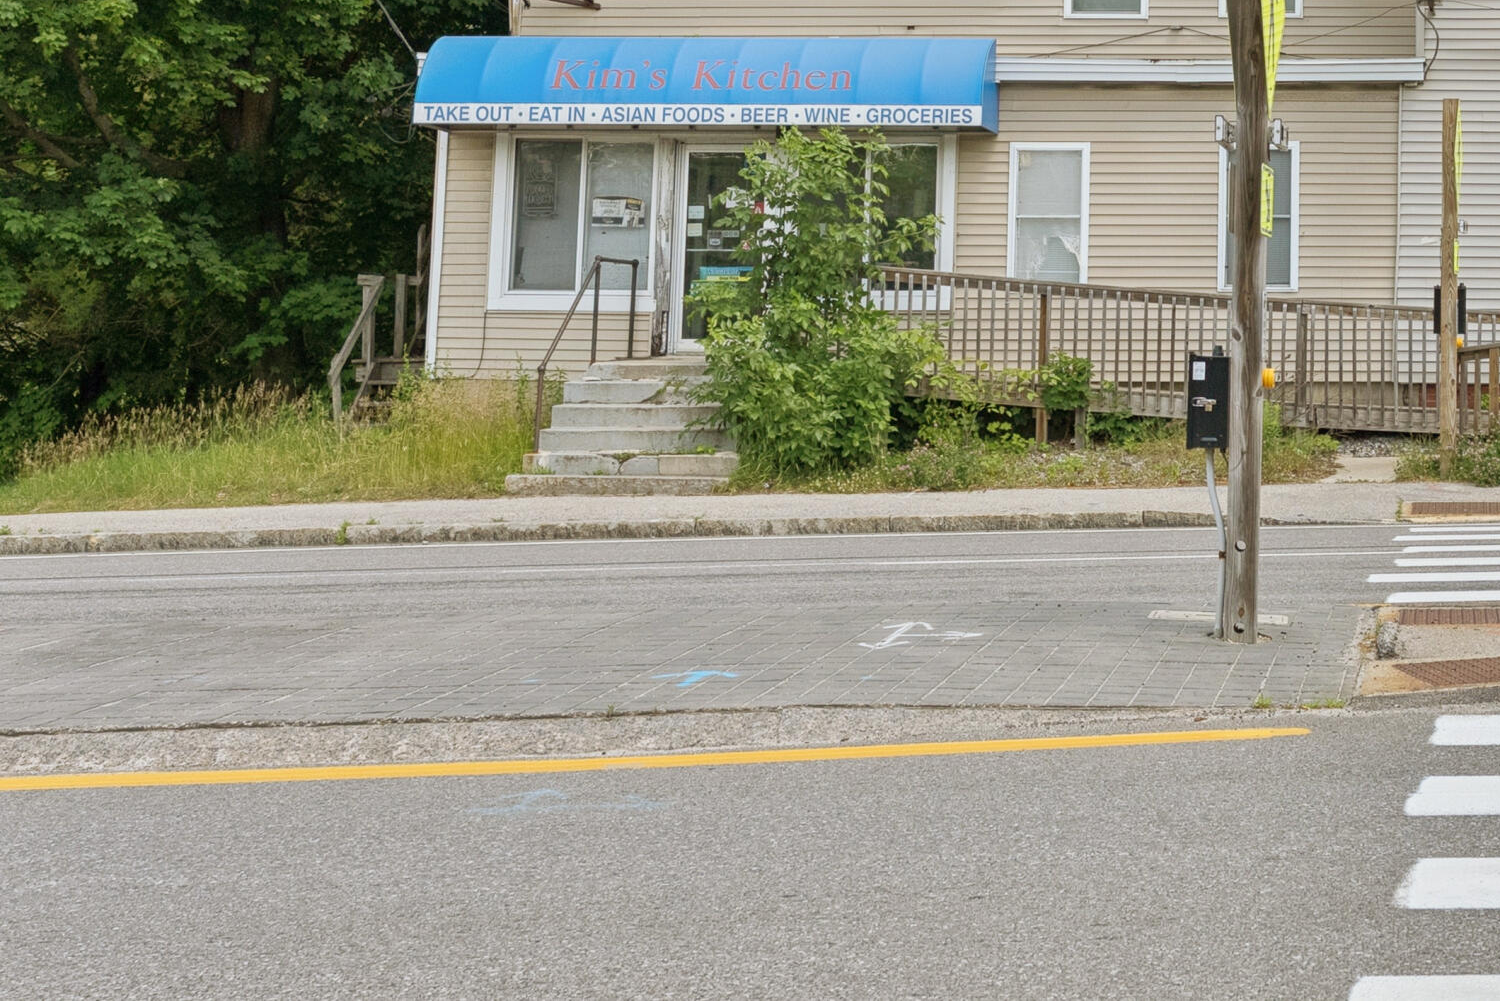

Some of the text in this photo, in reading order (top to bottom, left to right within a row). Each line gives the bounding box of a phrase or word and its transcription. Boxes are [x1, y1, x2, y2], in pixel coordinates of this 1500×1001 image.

[551, 59, 852, 91] Kim's Kitchen
[424, 106, 973, 124] TAKE OUT EAT IN ASIAN FOODS BEER WINE GROCERIES
